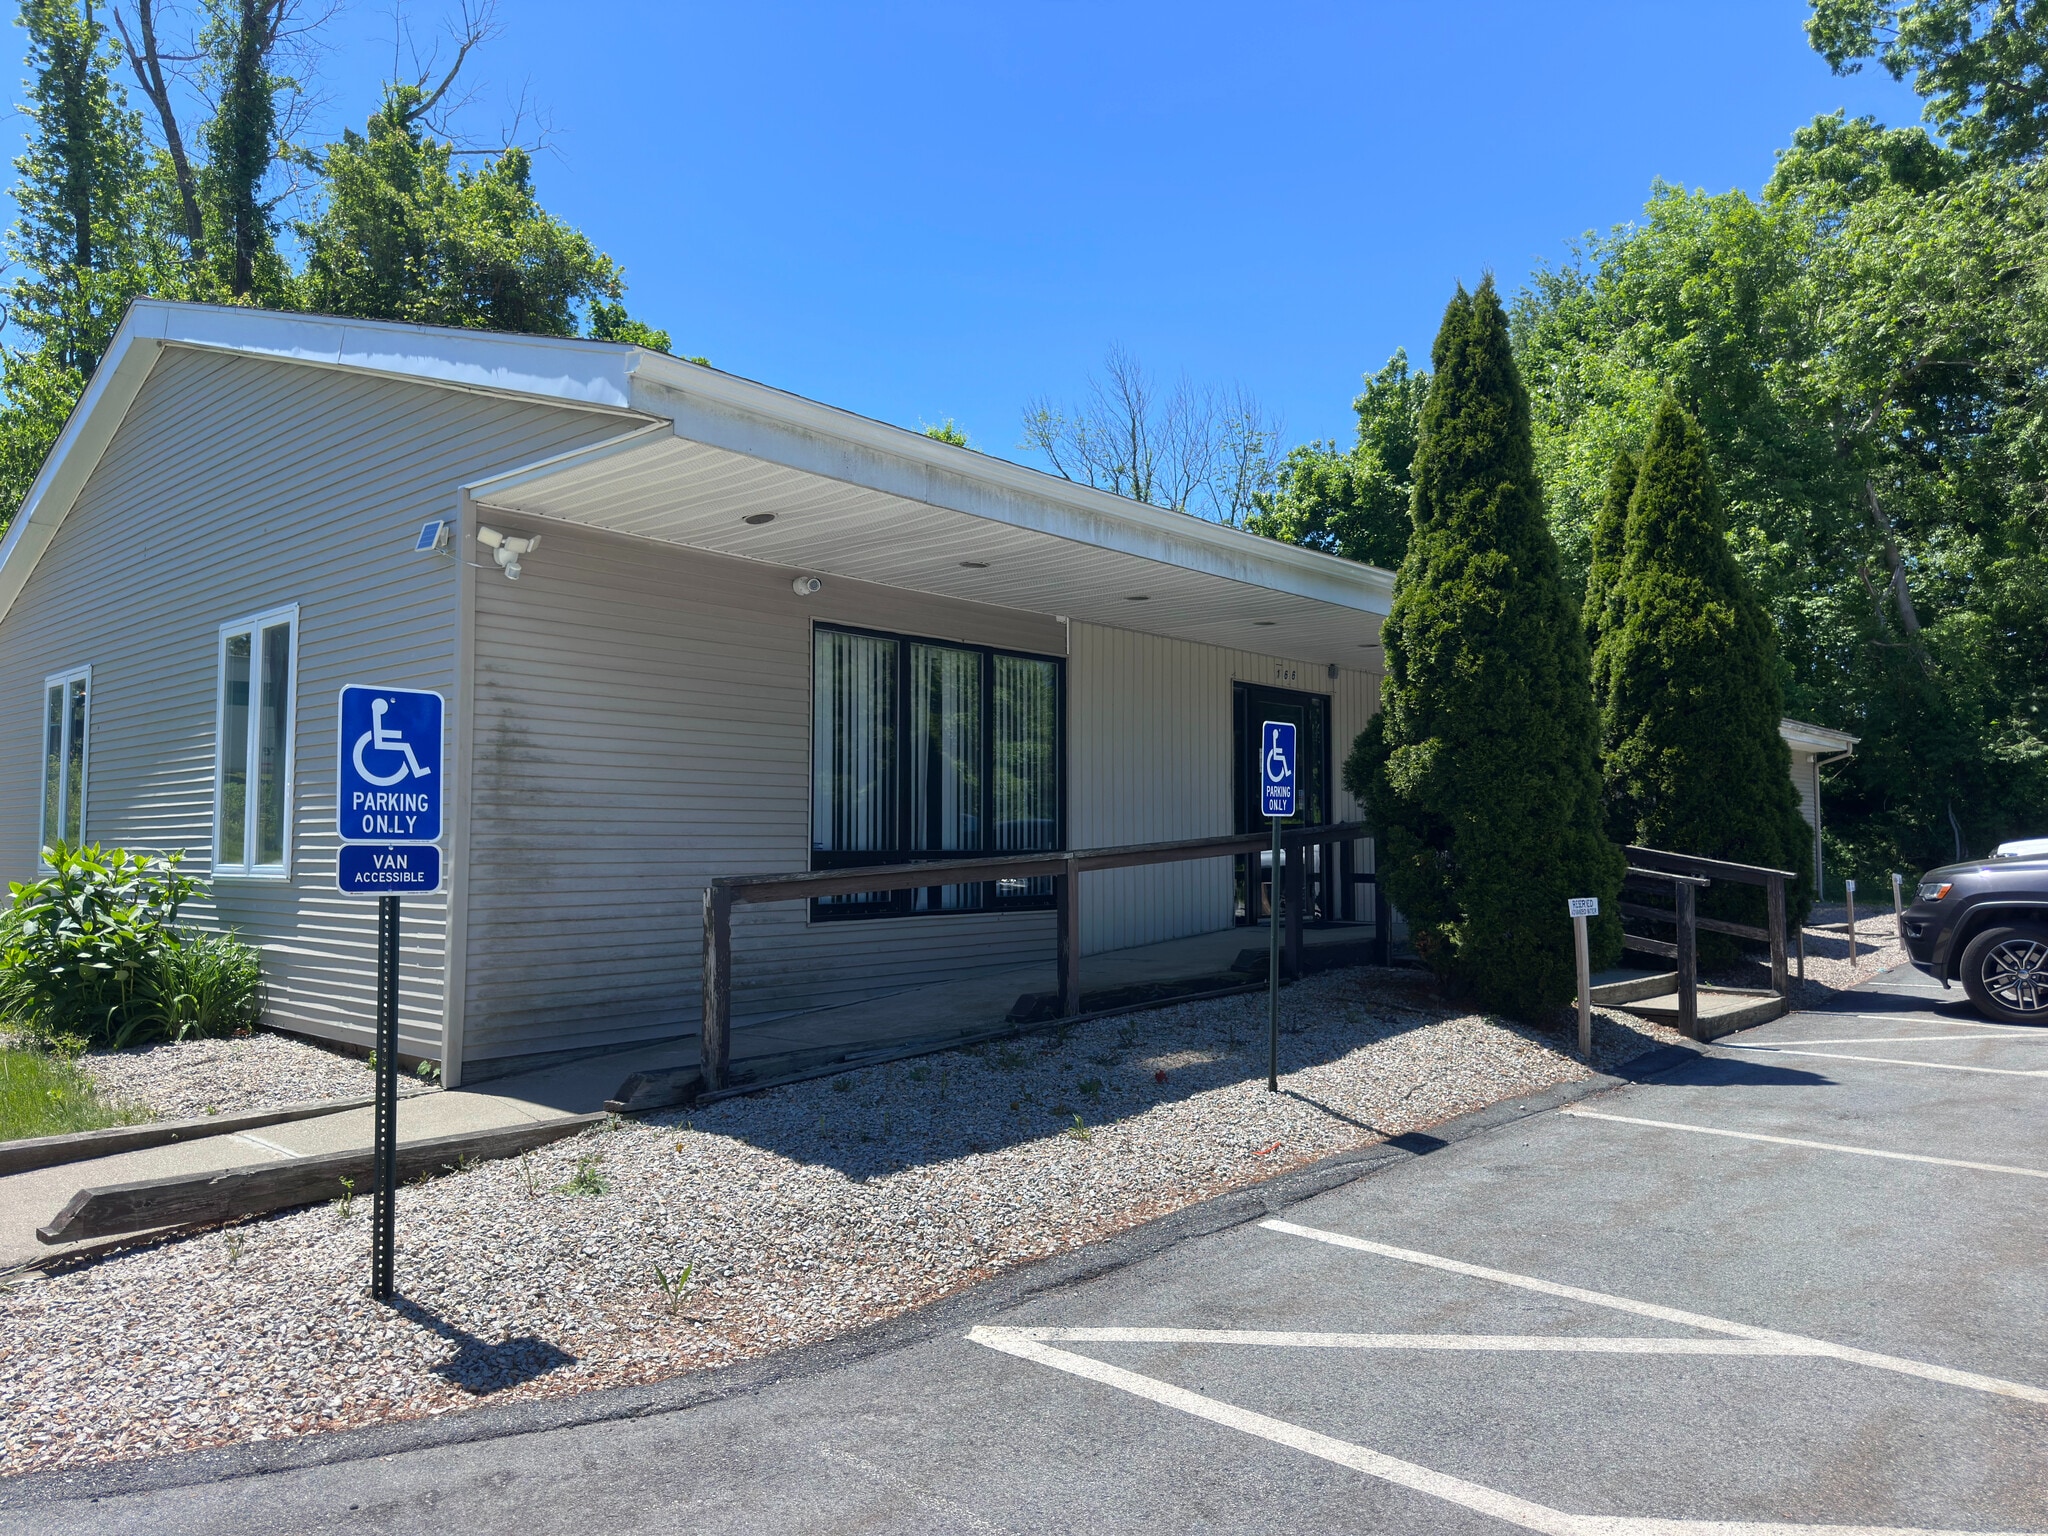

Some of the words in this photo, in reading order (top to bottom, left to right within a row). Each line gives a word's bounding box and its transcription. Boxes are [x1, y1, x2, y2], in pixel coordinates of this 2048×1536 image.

[1276, 669, 1296, 680] 166
[1266, 785, 1291, 798] PARKING
[353, 791, 429, 812] PARKING
[1269, 799, 1287, 811] ONLY
[362, 814, 417, 833] ONLY
[373, 854, 408, 869] VAN
[354, 871, 425, 883] ACCESSIBLE
